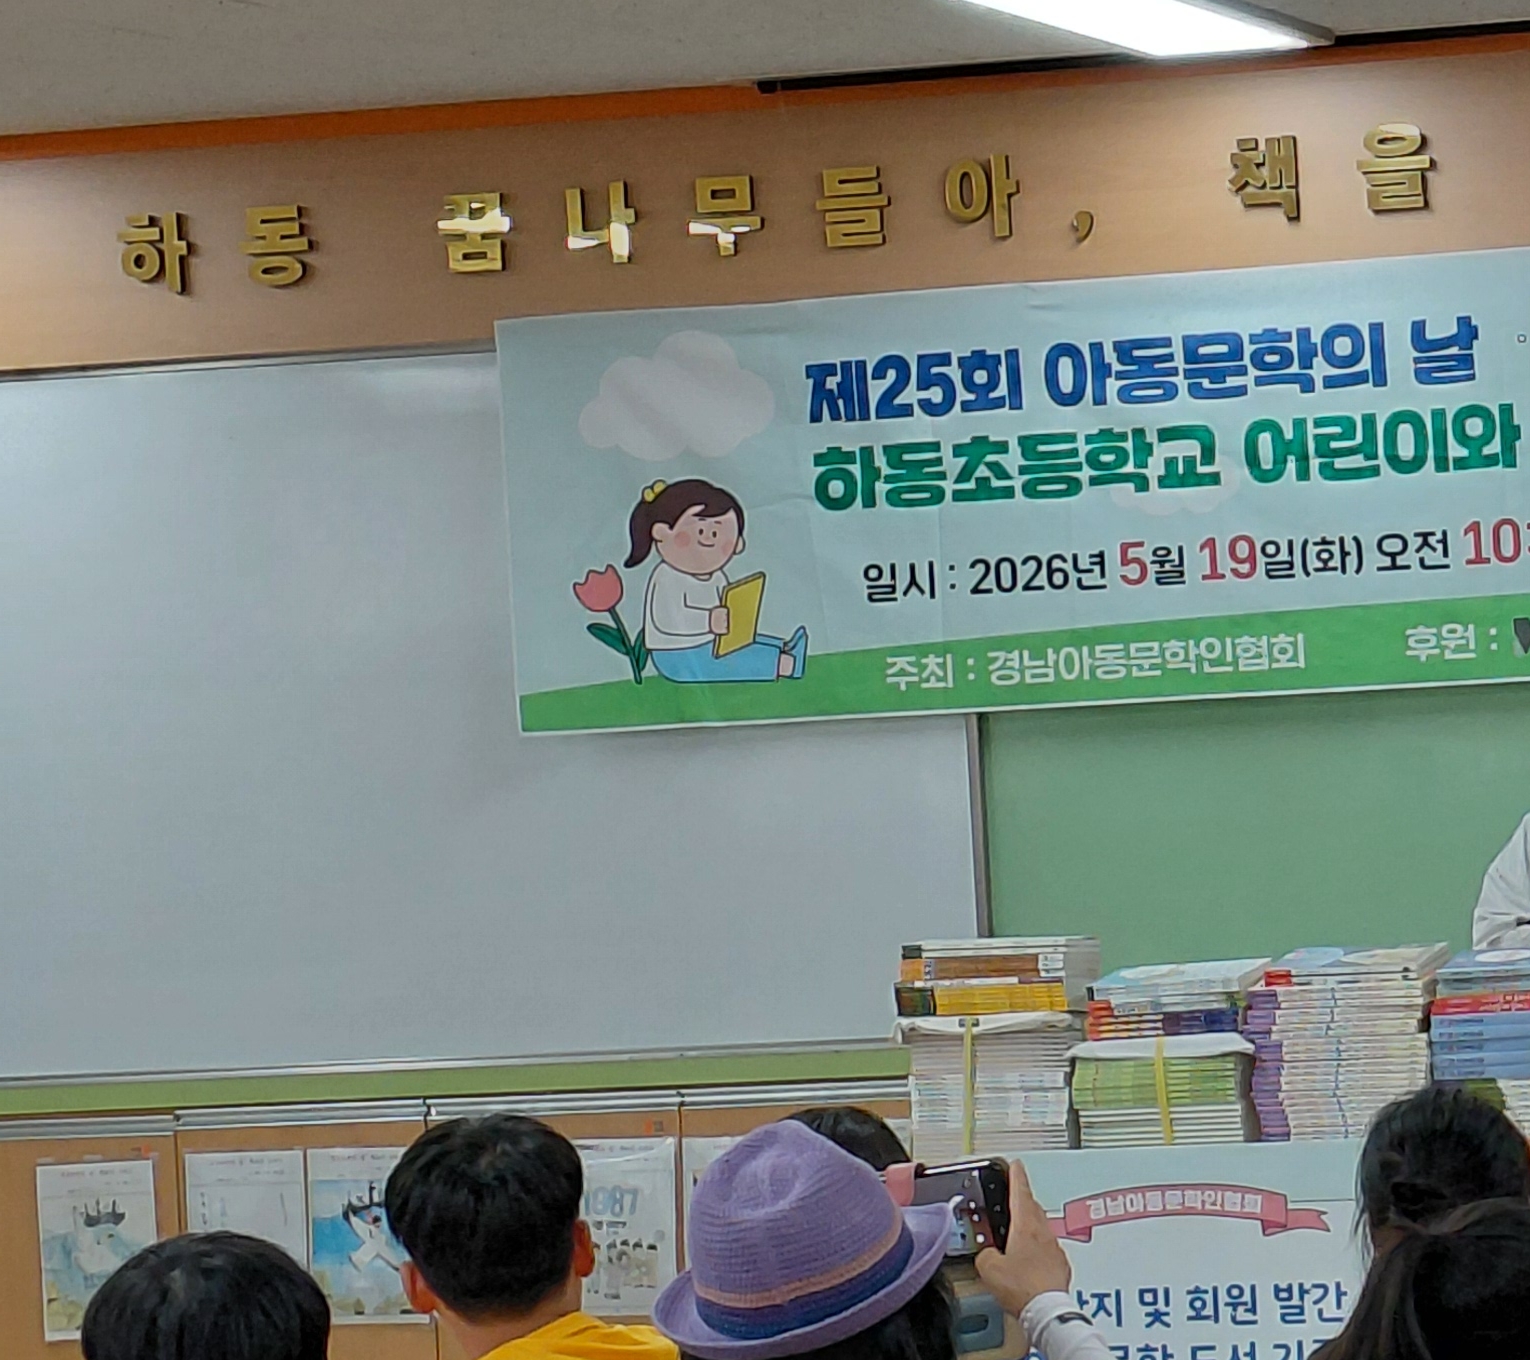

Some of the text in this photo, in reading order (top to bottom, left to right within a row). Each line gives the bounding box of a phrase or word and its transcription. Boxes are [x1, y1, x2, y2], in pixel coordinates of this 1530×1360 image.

[119, 205, 315, 293] 하동
[437, 154, 1094, 274] 꿈나무들아,
[1228, 122, 1436, 221] 책을
[804, 315, 1480, 424] 제25회 아동문학의 날
[812, 424, 1222, 511] 하동초등학교
[1243, 402, 1522, 483] 어린이와
[968, 549, 1108, 596] 2026년
[1118, 540, 1188, 586] 5월
[1199, 533, 1364, 582] 19일(화)
[1375, 528, 1451, 573] 오전
[986, 631, 1307, 687] 경남아동문학인협회
[1137, 1286, 1171, 1329] 및
[1185, 1284, 1259, 1326] 회원
[1272, 1280, 1347, 1324] 발간
